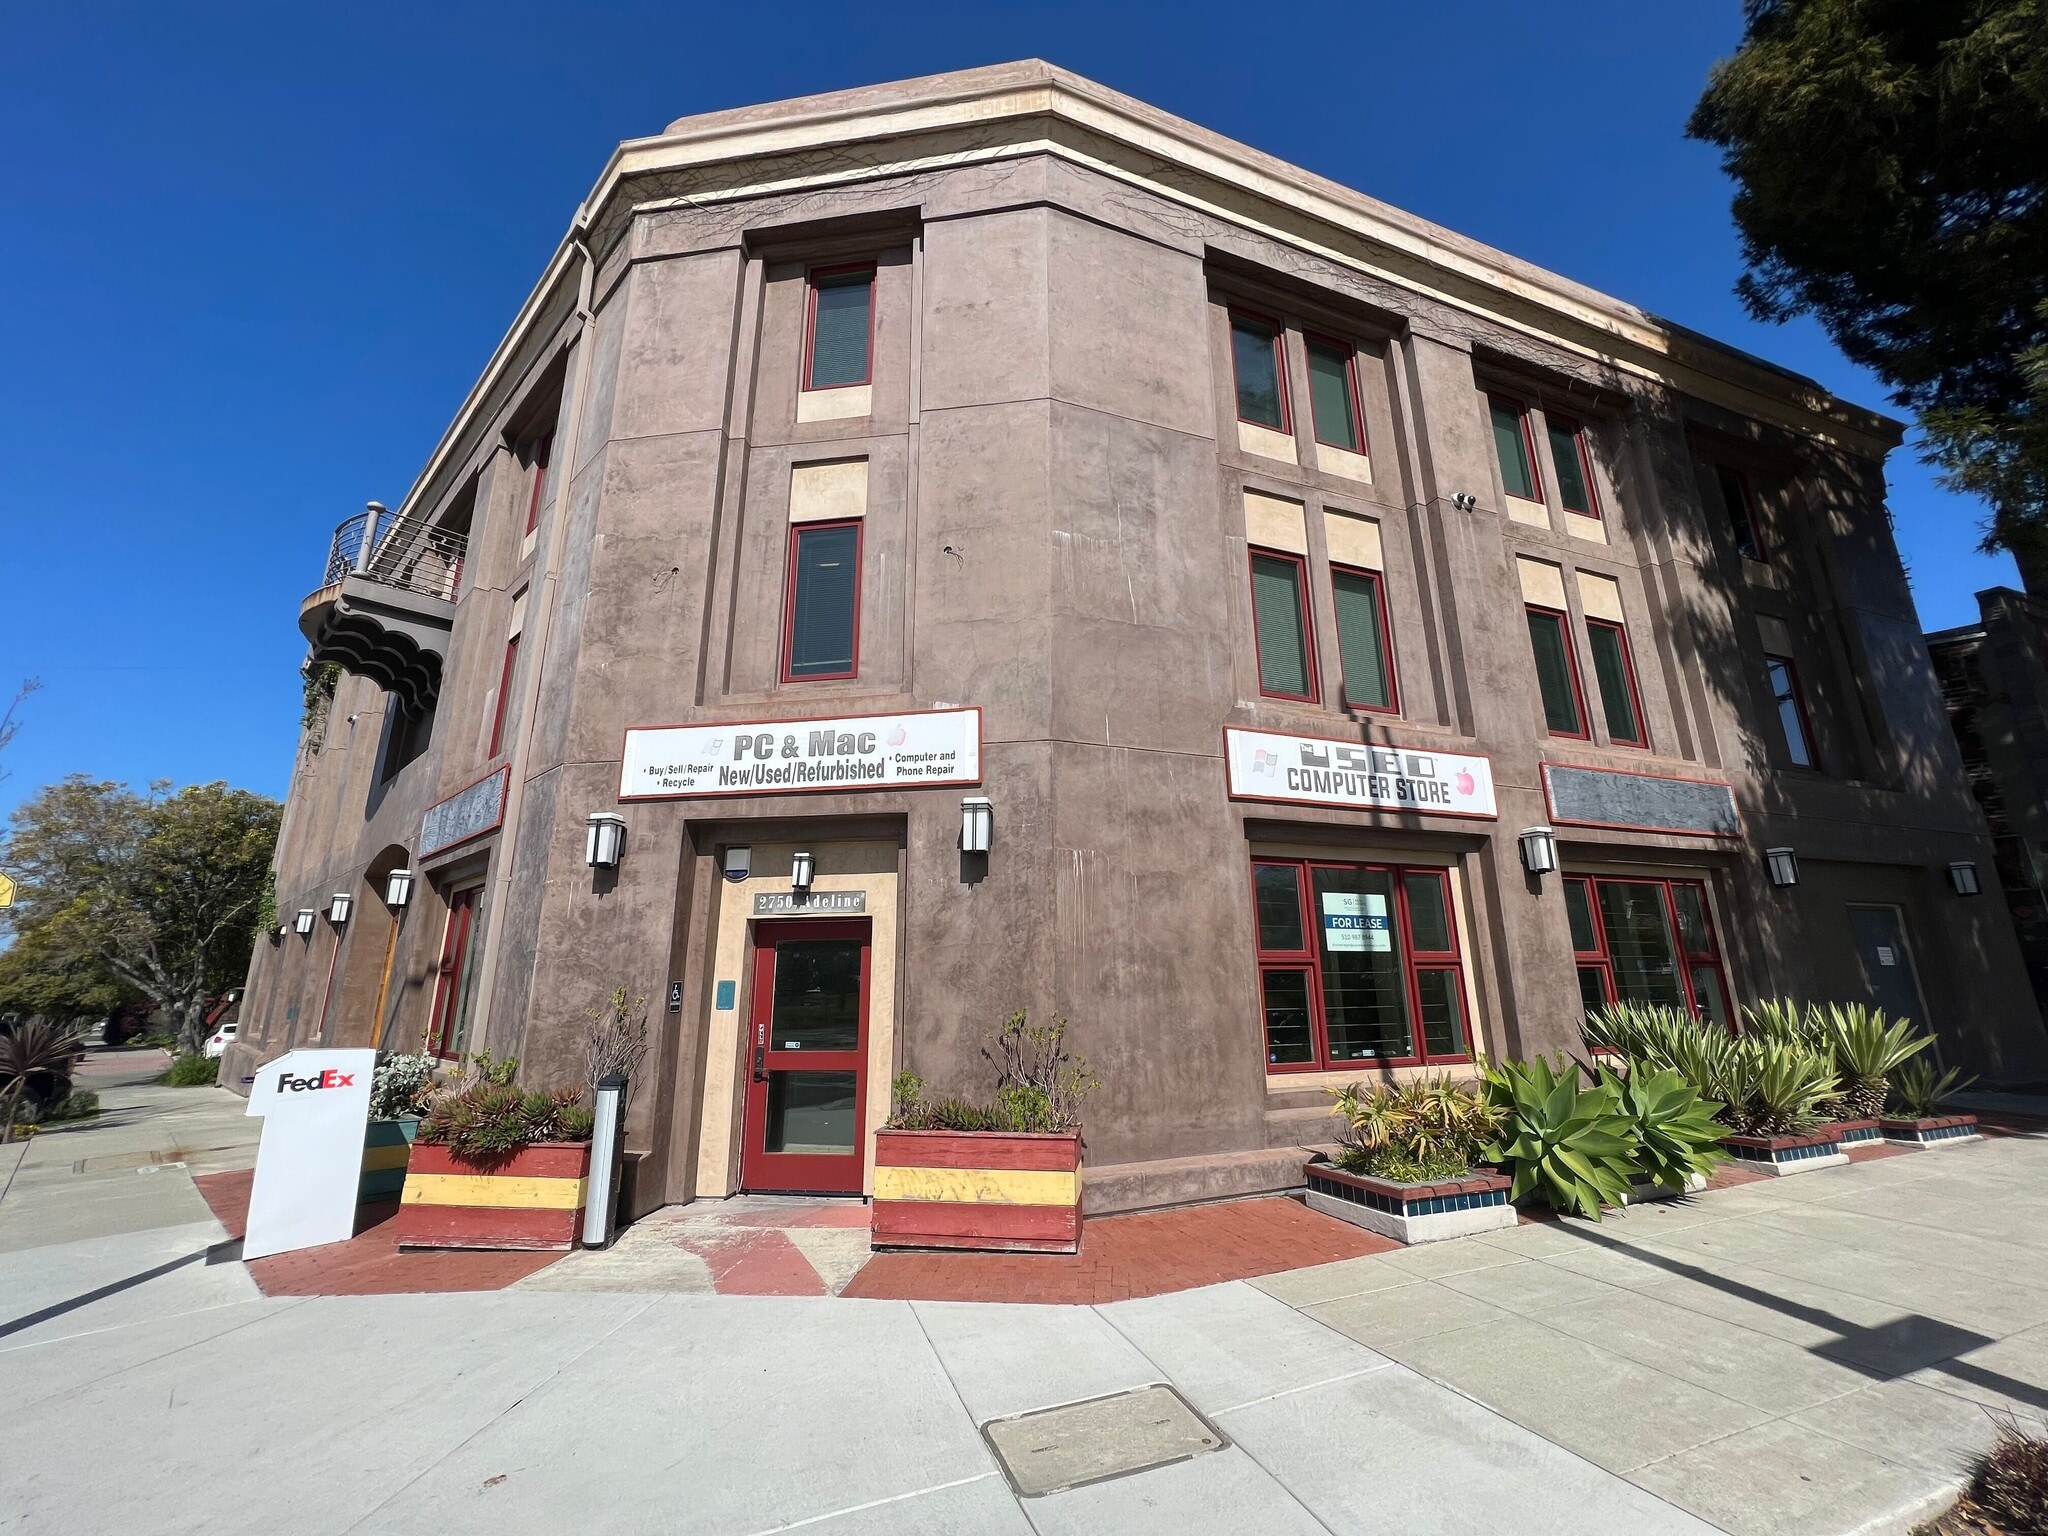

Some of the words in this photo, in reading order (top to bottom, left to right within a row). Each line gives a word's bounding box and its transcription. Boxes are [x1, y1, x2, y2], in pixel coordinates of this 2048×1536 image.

[733, 733, 774, 760] PC
[780, 734, 800, 759] &
[808, 730, 876, 757] Mac
[895, 751, 937, 763] Computer
[939, 750, 956, 761] and
[1299, 742, 1436, 778] USED
[649, 763, 714, 777] Buy/Sell/Repair
[718, 757, 885, 787] New/Used/Refurbished
[896, 766, 923, 776] Phone
[926, 763, 955, 776] Repair
[662, 776, 695, 789] Recycle
[1287, 767, 1391, 799] COMPUTER
[1396, 778, 1451, 804] STORE
[759, 895, 793, 909] 2750
[1343, 898, 1353, 906] SG
[1332, 917, 1352, 928] FOR
[1353, 918, 1383, 929] LEASE
[277, 1069, 356, 1093] FedEx
